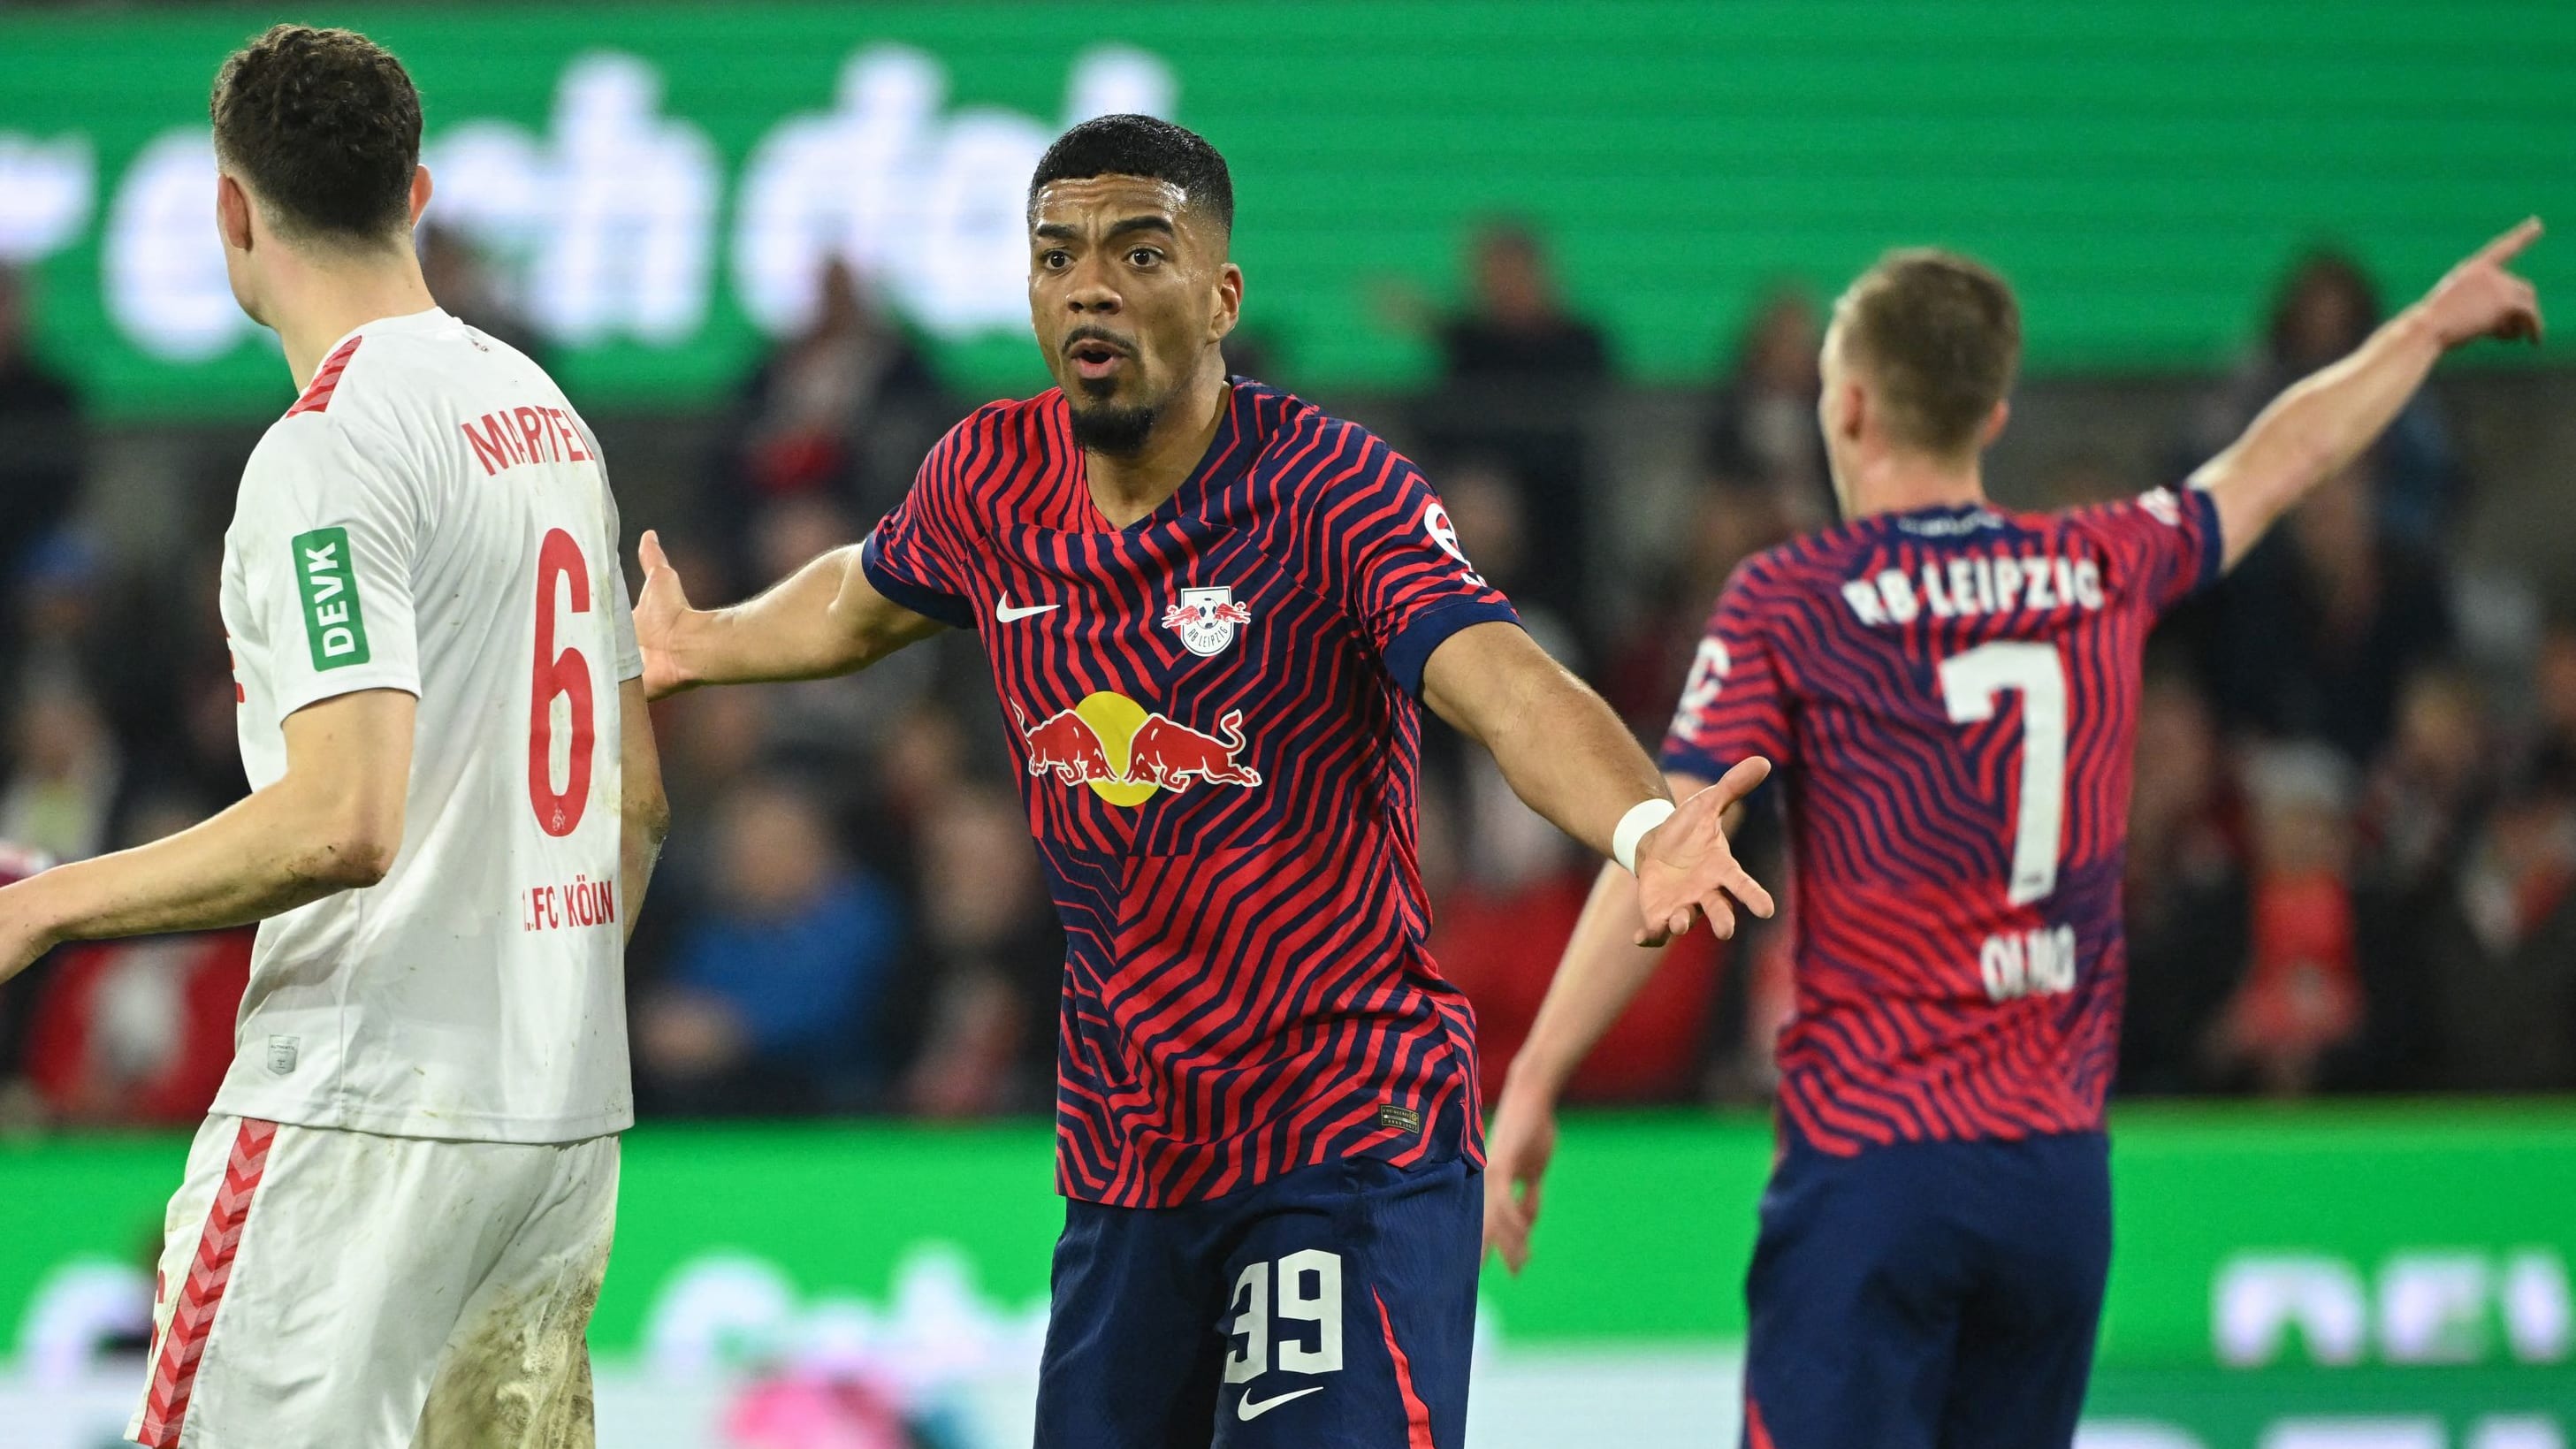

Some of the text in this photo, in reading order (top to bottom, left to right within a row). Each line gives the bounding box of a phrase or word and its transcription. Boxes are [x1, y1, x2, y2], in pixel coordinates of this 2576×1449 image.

[305, 542, 355, 657] DEVK
[1187, 626, 1228, 647] RB LEIPZIG
[1841, 554, 2105, 626] RB LEIPZIG
[529, 528, 595, 837] 6
[1939, 641, 2067, 907] 7
[563, 873, 614, 927] KÖLN
[1224, 1249, 1343, 1384] 39
